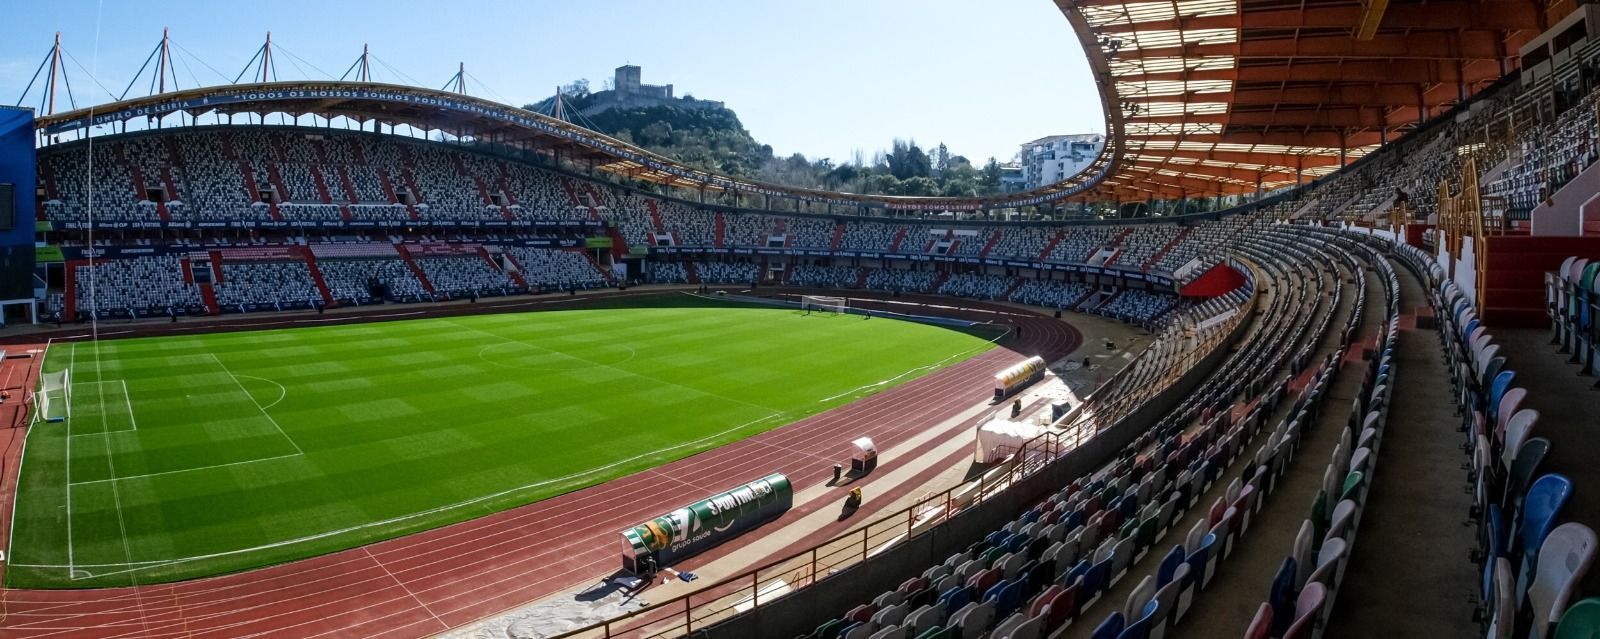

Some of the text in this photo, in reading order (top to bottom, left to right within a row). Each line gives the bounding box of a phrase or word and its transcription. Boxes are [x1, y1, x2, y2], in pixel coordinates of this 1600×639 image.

[363, 92, 410, 101] SONHOS
[414, 96, 452, 107] PODEM
[137, 107, 150, 116] DE
[154, 101, 190, 113] LEIRIA
[671, 539, 691, 553] grupo
